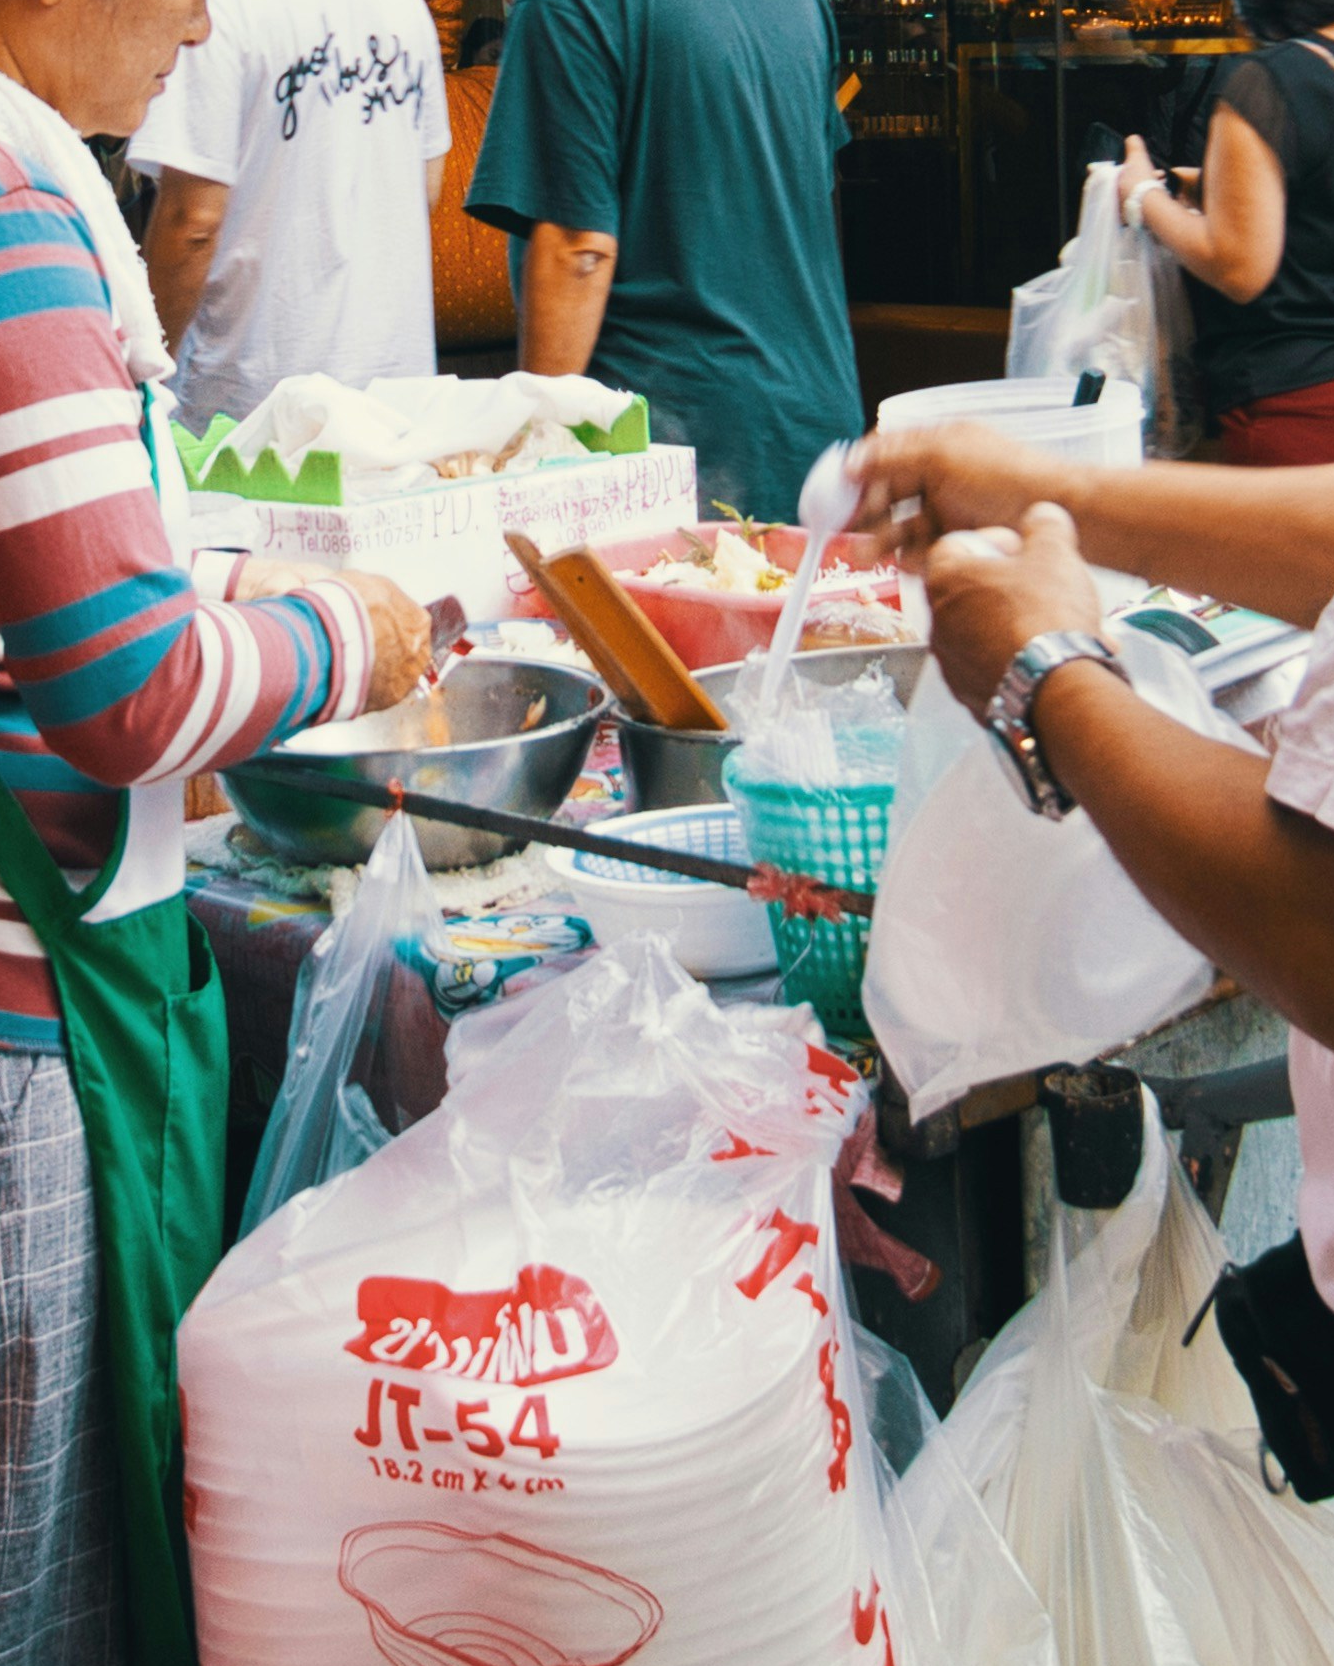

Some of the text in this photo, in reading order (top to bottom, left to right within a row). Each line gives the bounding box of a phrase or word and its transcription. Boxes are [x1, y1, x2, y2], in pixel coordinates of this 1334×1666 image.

[353, 1377, 561, 1460] JT-54
[368, 1455, 424, 1484] 18.2
[431, 1467, 465, 1492] cm
